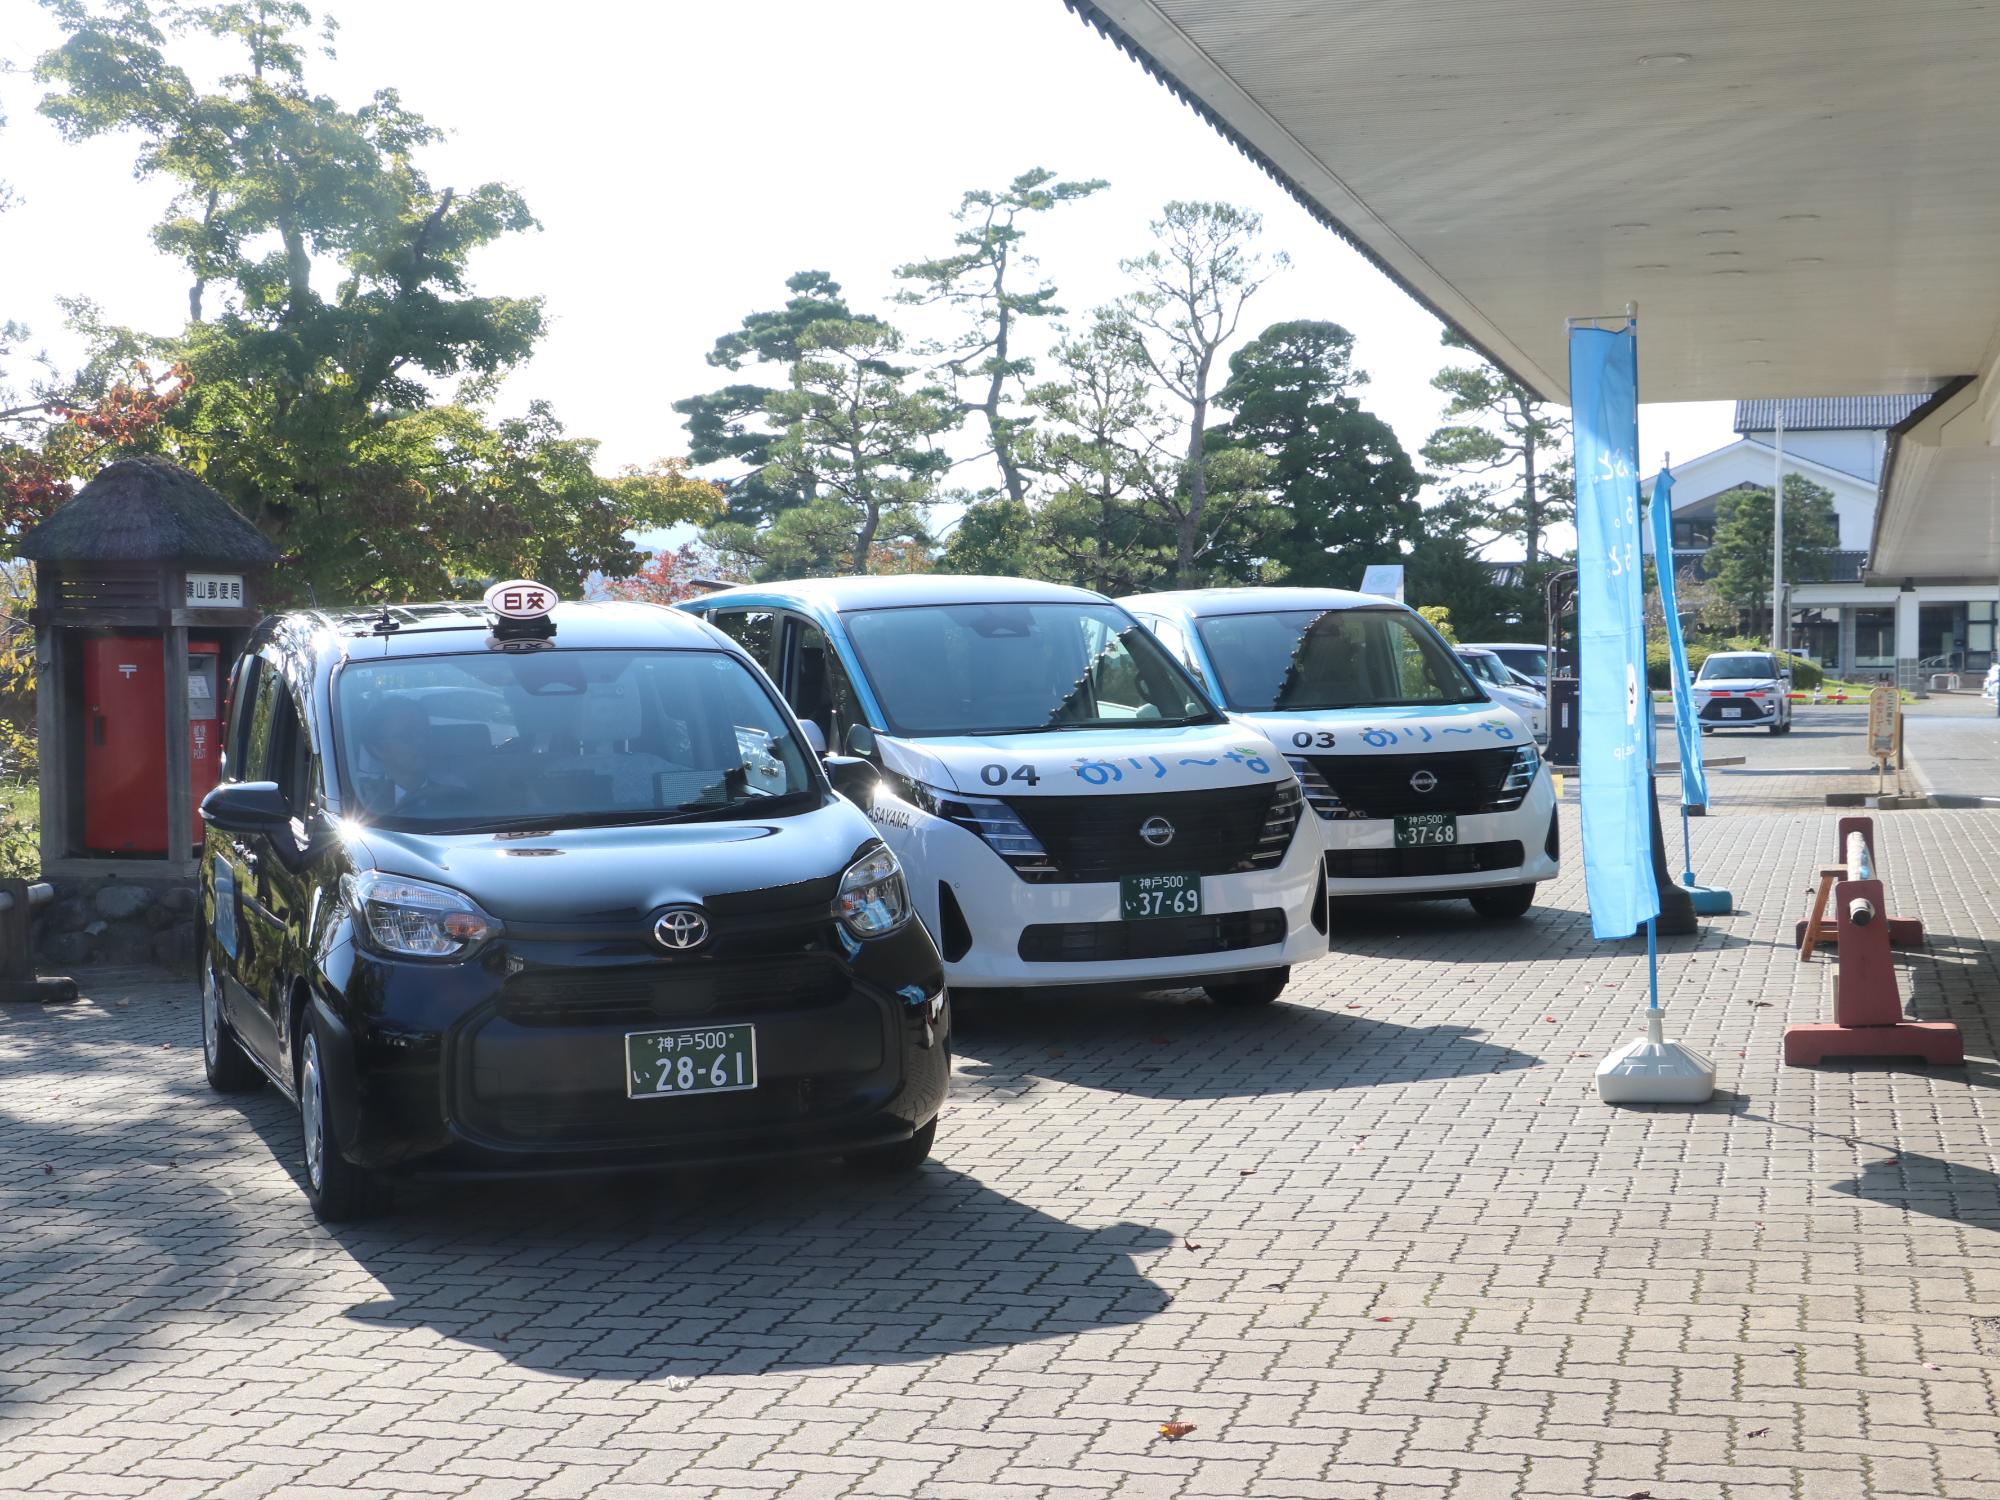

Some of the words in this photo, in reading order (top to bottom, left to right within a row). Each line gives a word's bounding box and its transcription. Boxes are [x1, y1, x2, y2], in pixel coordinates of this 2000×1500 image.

[504, 592, 545, 610] 日交
[1292, 732, 1336, 748] 03
[980, 764, 1041, 786] 04
[867, 807, 910, 830] ASAYAMA
